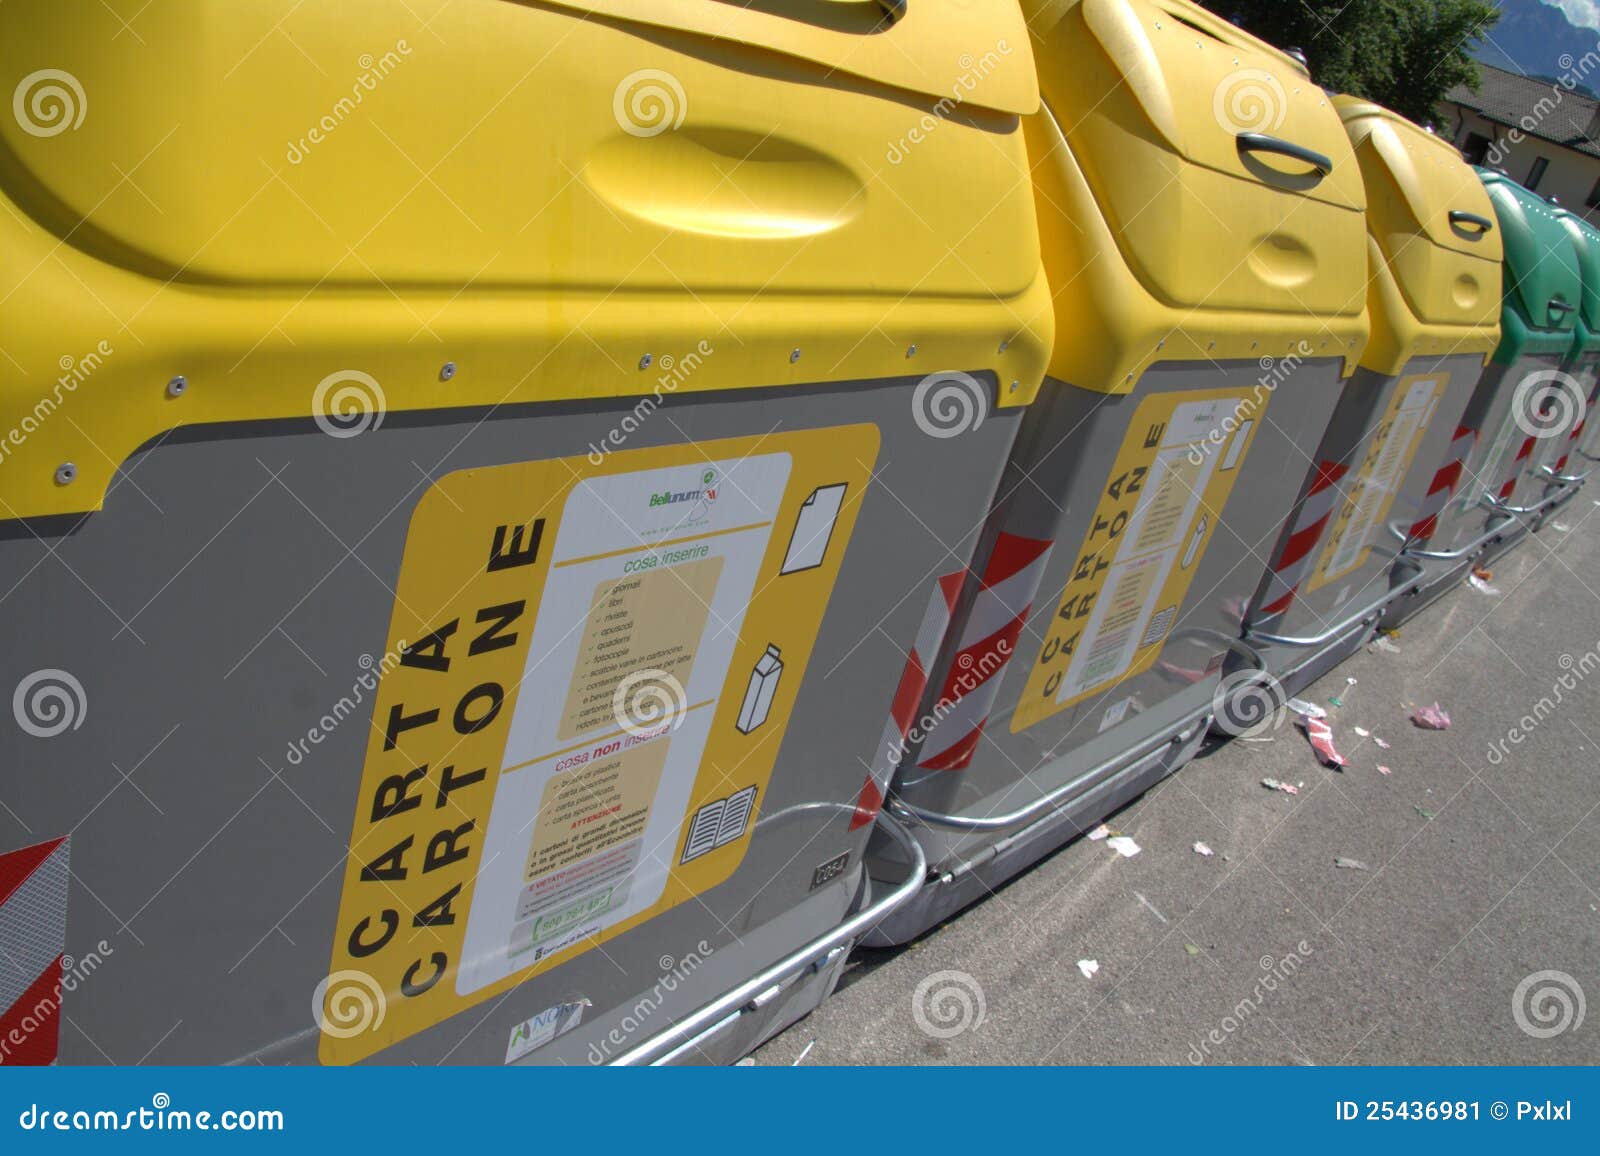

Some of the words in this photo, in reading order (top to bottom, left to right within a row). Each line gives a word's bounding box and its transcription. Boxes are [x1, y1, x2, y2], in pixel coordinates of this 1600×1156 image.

[622, 554, 659, 573] cosa
[660, 541, 711, 565] inserire
[1041, 472, 1128, 664] CARTA
[1043, 422, 1166, 698] CARTONE
[348, 617, 460, 958] CARTA
[401, 518, 546, 997] CARTONE
[555, 750, 589, 772] cosa
[592, 740, 621, 759] non
[569, 803, 623, 830] ATTENZIONE
